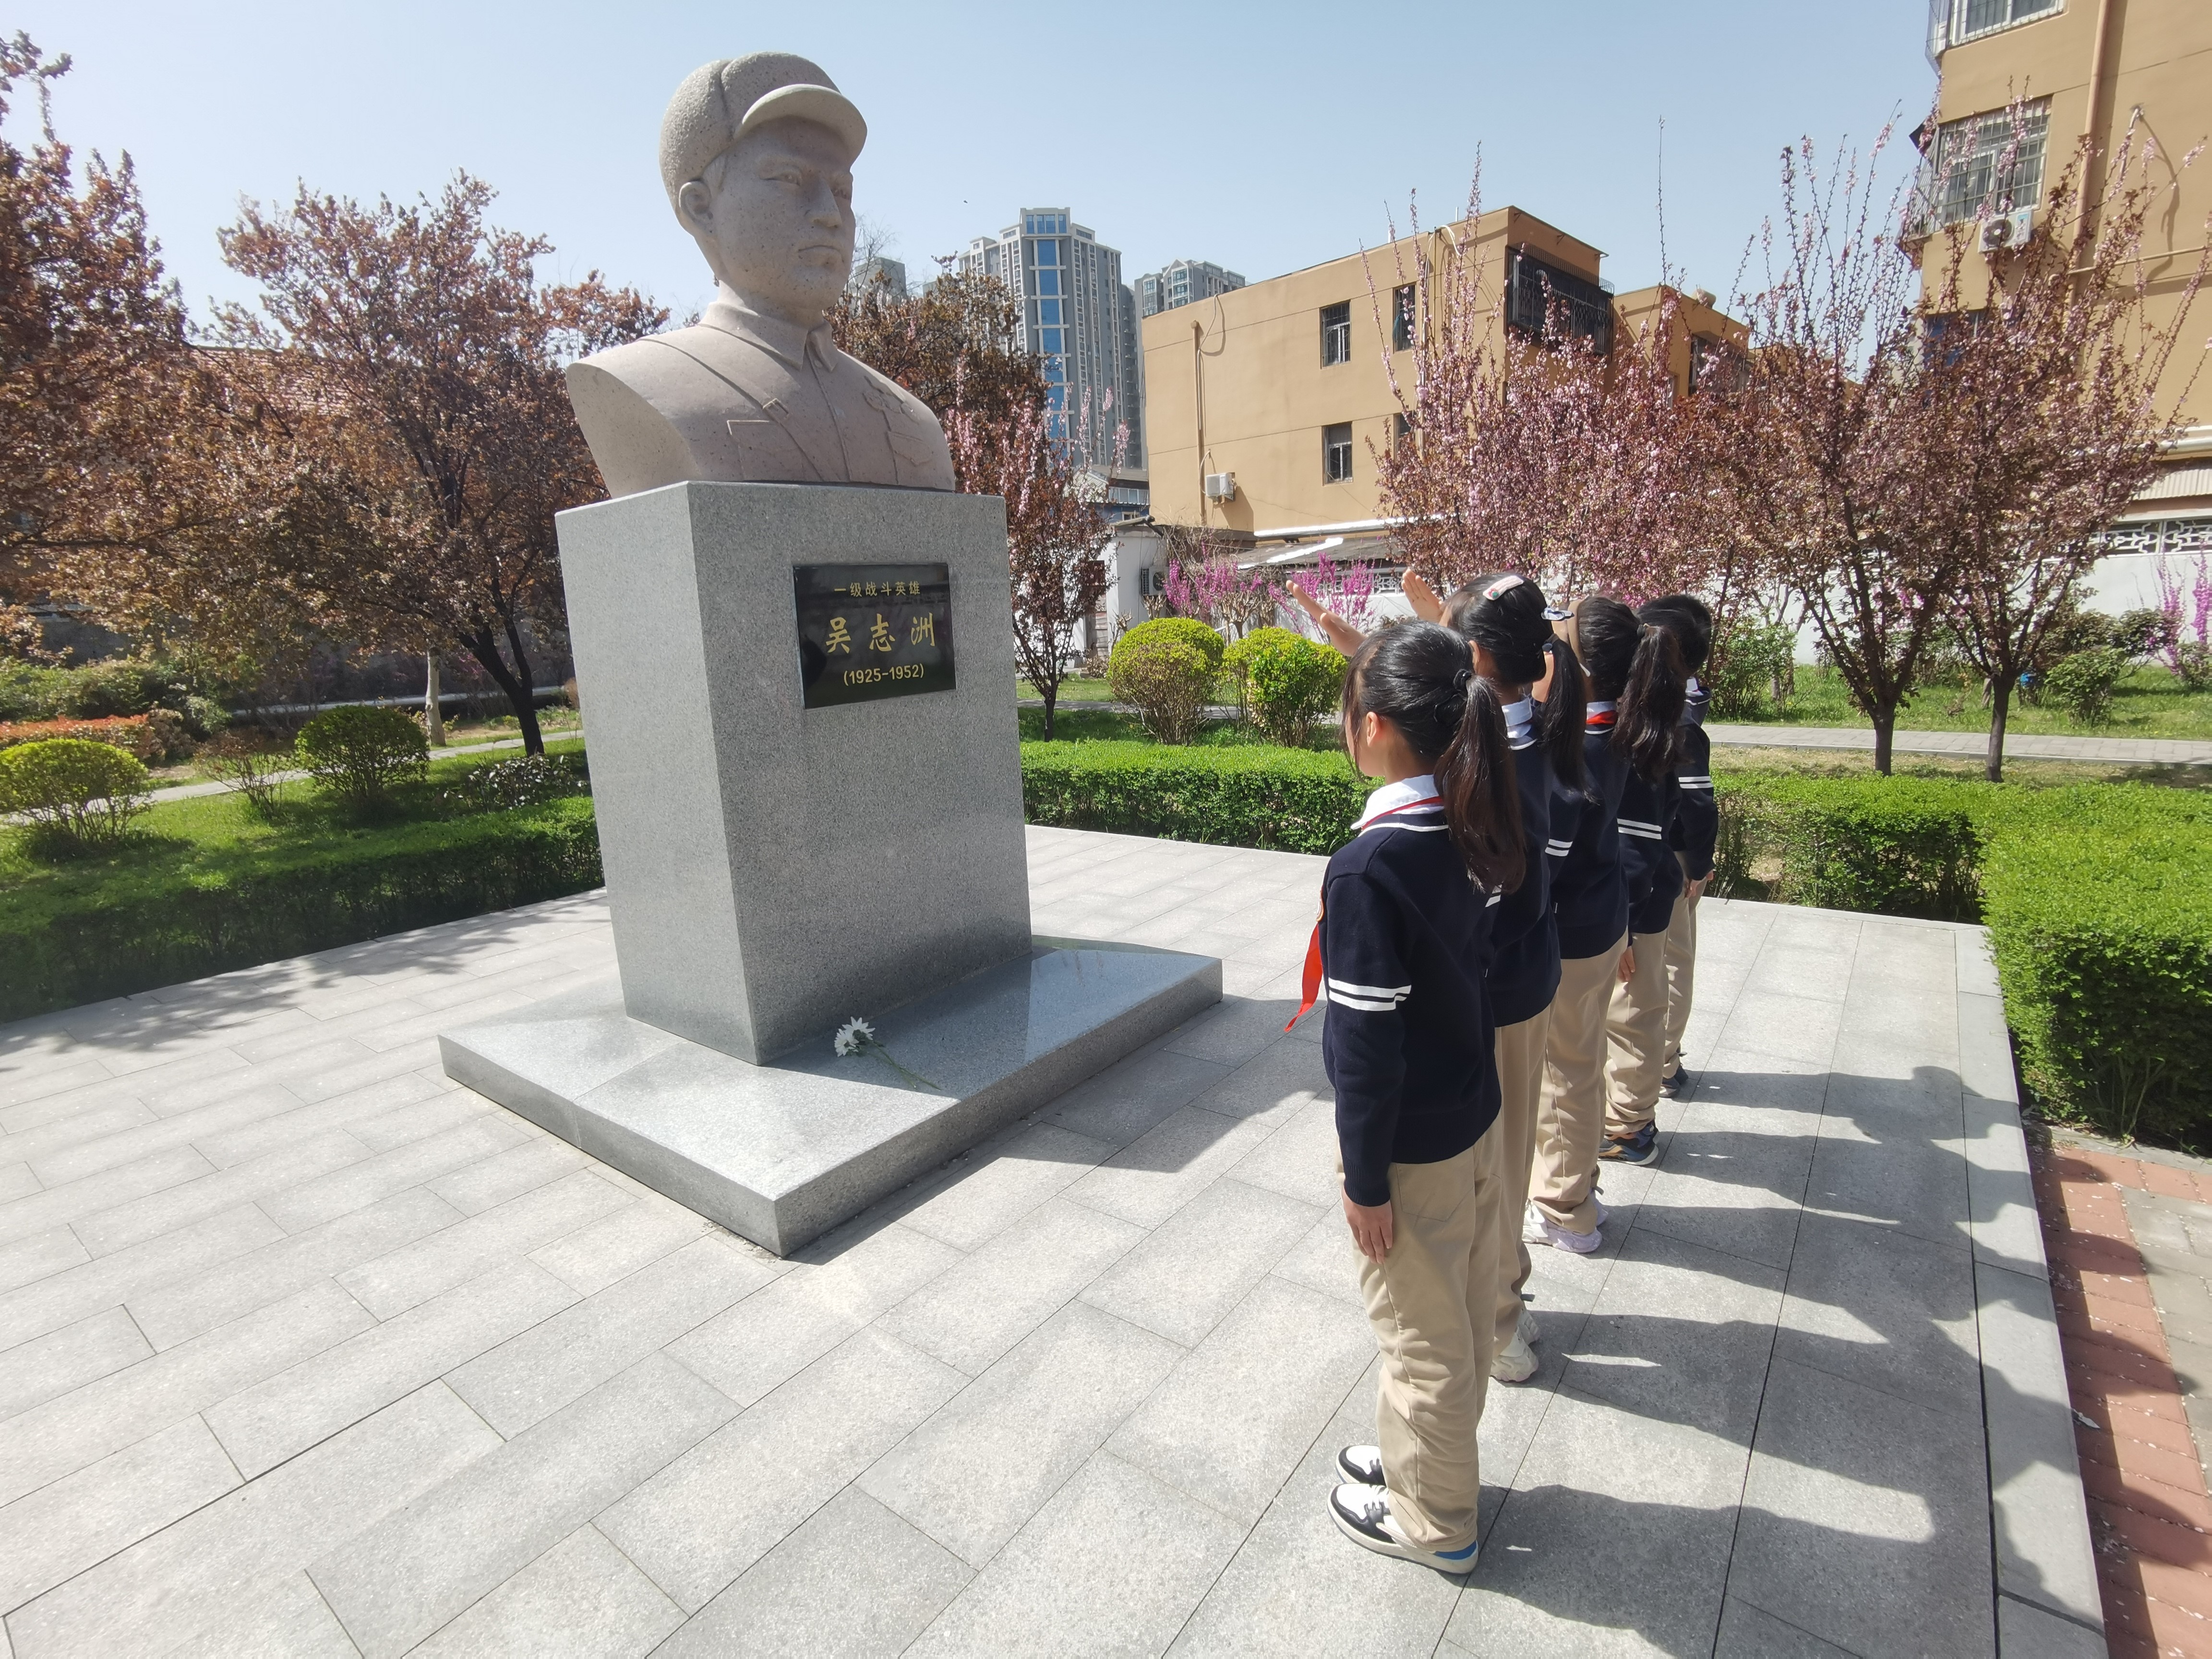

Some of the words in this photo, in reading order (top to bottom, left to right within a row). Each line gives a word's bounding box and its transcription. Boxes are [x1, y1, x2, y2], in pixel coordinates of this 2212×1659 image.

[834, 580, 921, 598] 一级战斗英雄
[826, 612, 935, 654] 吴志洲
[843, 663, 924, 686] (1925-1952)
